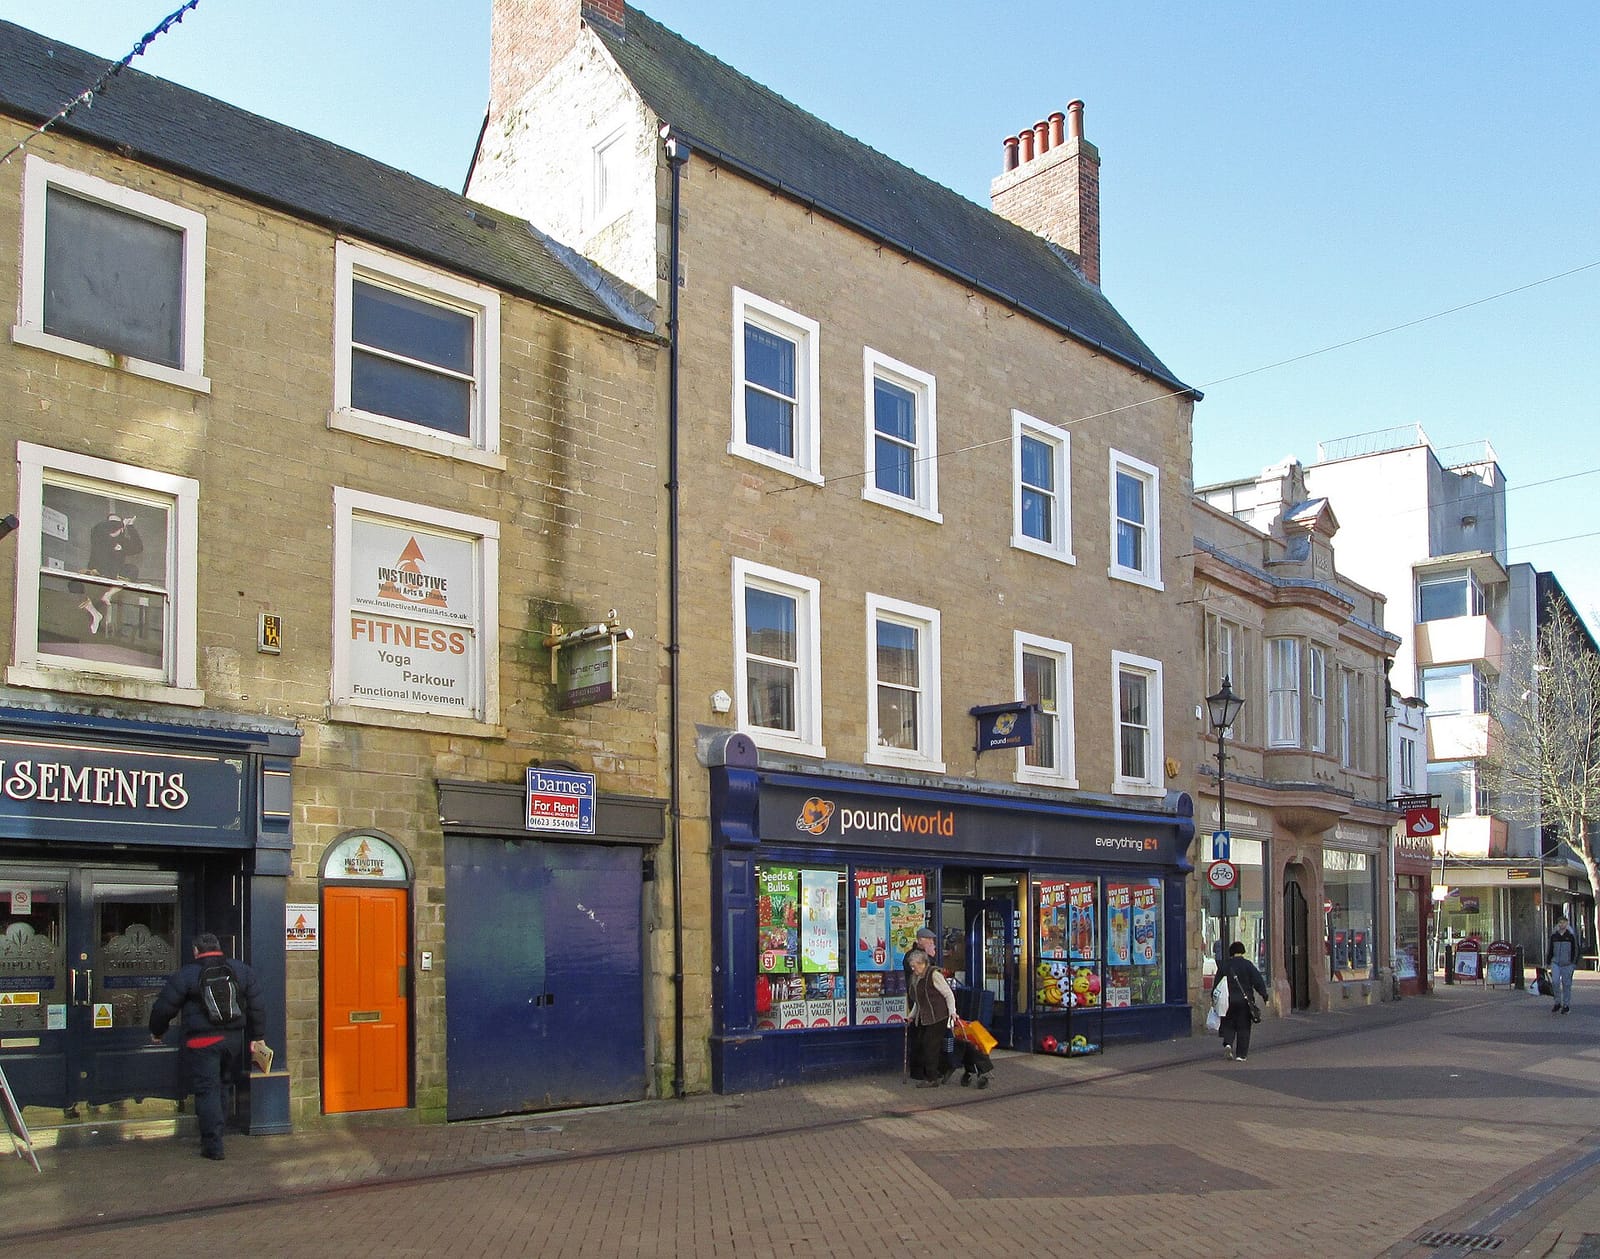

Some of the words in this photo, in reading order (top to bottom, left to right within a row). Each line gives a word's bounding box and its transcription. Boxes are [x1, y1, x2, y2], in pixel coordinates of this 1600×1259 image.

[379, 567, 447, 591] INSTINCTIVE
[403, 588, 417, 597] Arts
[351, 618, 465, 655] FITNESS
[378, 651, 411, 667] Yoga
[403, 671, 455, 687] Parkour
[353, 685, 409, 699] Functional
[412, 691, 465, 705] Movement
[537, 774, 587, 794] barnes
[534, 800, 551, 811] For
[554, 802, 576, 813] Rent
[841, 808, 954, 836] poundworld
[1095, 837, 1143, 851] everything
[1144, 838, 1158, 850] £1
[345, 858, 384, 867] INSTINCTIVE
[762, 871, 787, 881] Seeds
[788, 871, 794, 880] &
[857, 878, 870, 886] YOU
[872, 876, 887, 884] SAVE
[768, 883, 790, 892] Bulbs
[906, 878, 922, 886] SAVE
[764, 958, 773, 967] £1
[876, 955, 883, 963] £1
[784, 1009, 804, 1017] VALUE!
